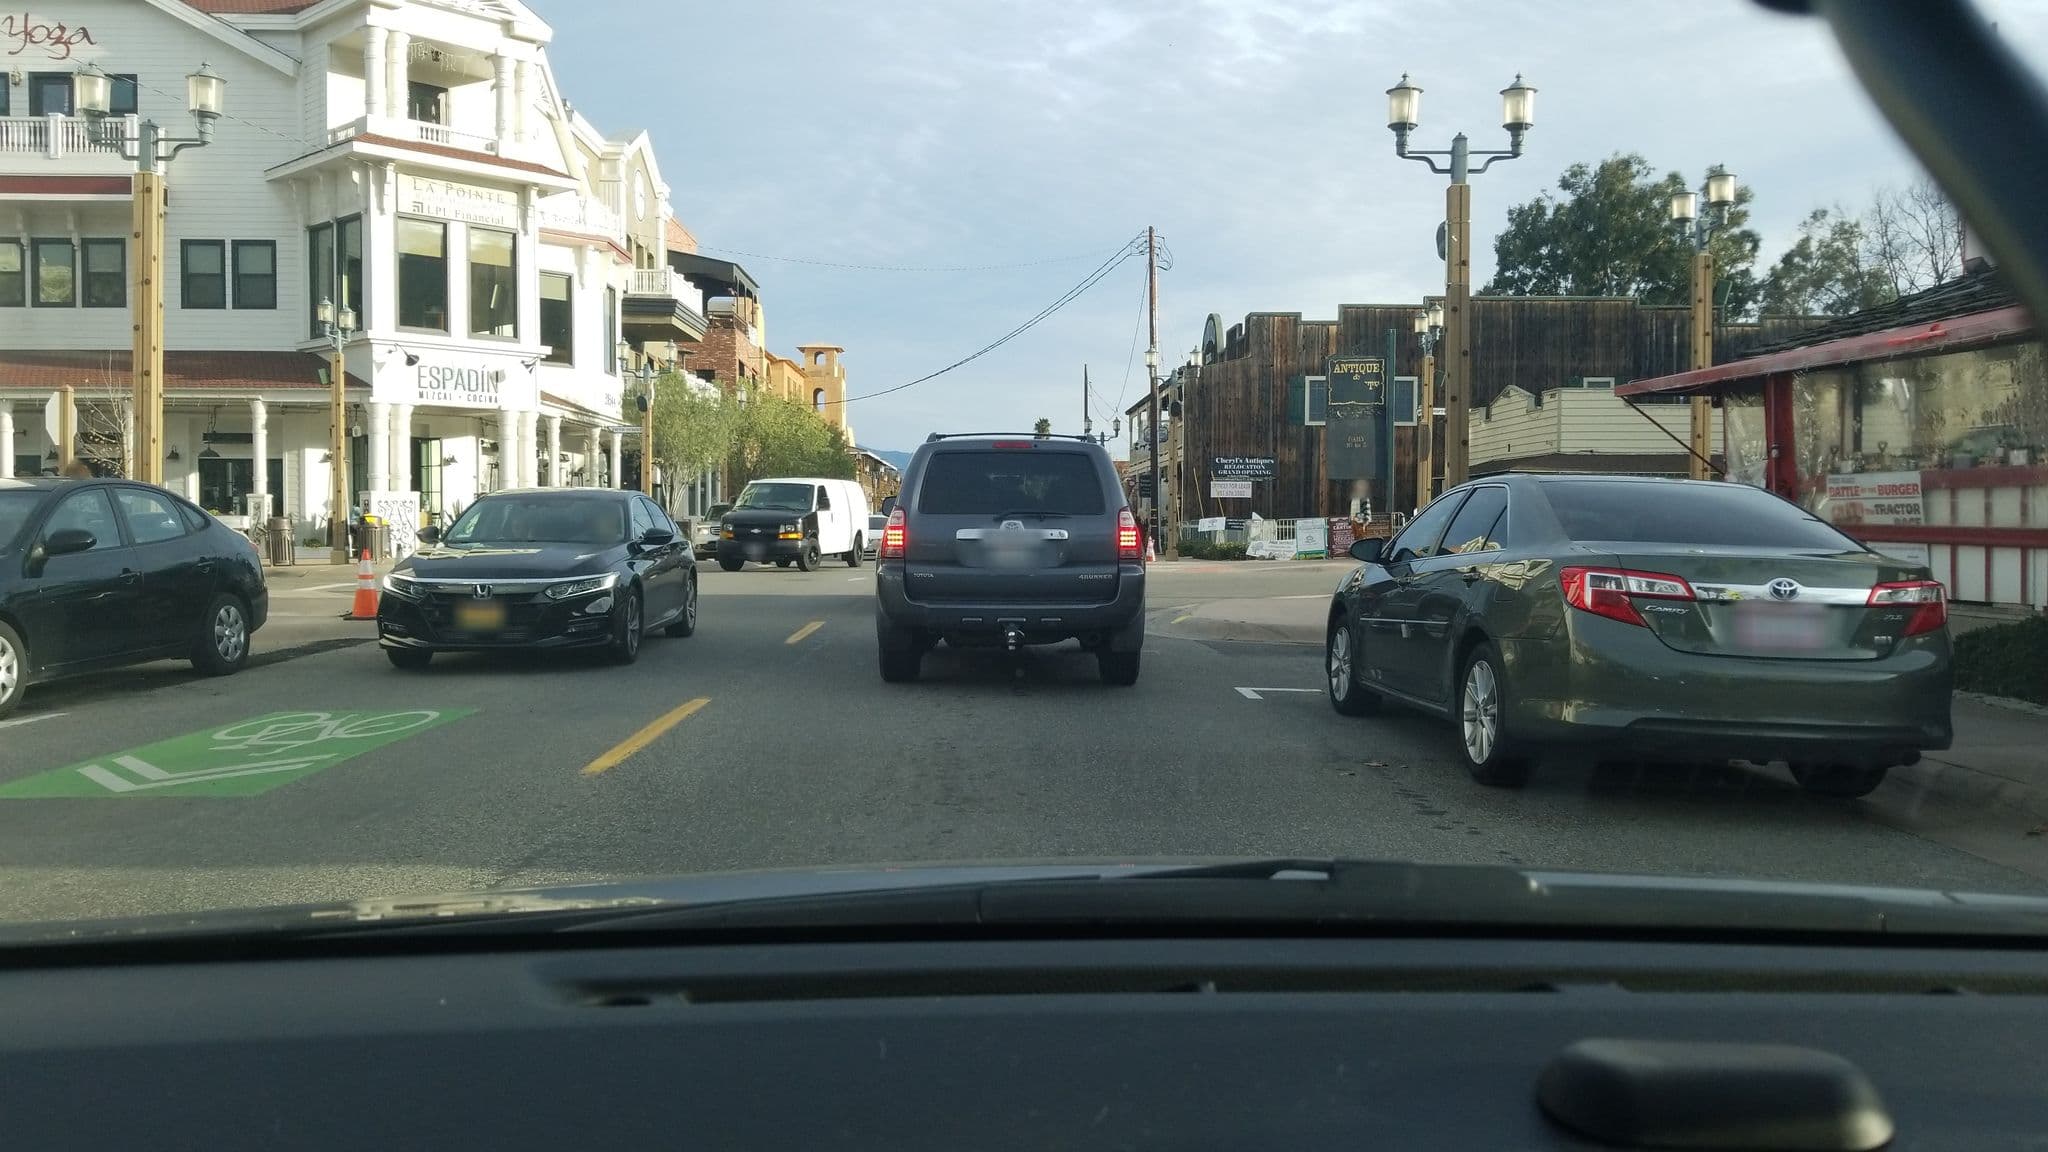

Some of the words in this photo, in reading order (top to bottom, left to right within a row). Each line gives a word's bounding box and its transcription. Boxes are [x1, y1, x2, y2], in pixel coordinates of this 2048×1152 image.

[455, 209, 504, 225] Financial
[1333, 363, 1380, 375] ANTIQUE
[417, 364, 499, 394] ESPADÍN
[1215, 457, 1243, 465] Cheryl's
[1245, 457, 1274, 465] Antiques
[1828, 485, 1860, 497] BATTLE
[1877, 483, 1920, 496] BURGER
[1874, 503, 1921, 515] TRACTOR
